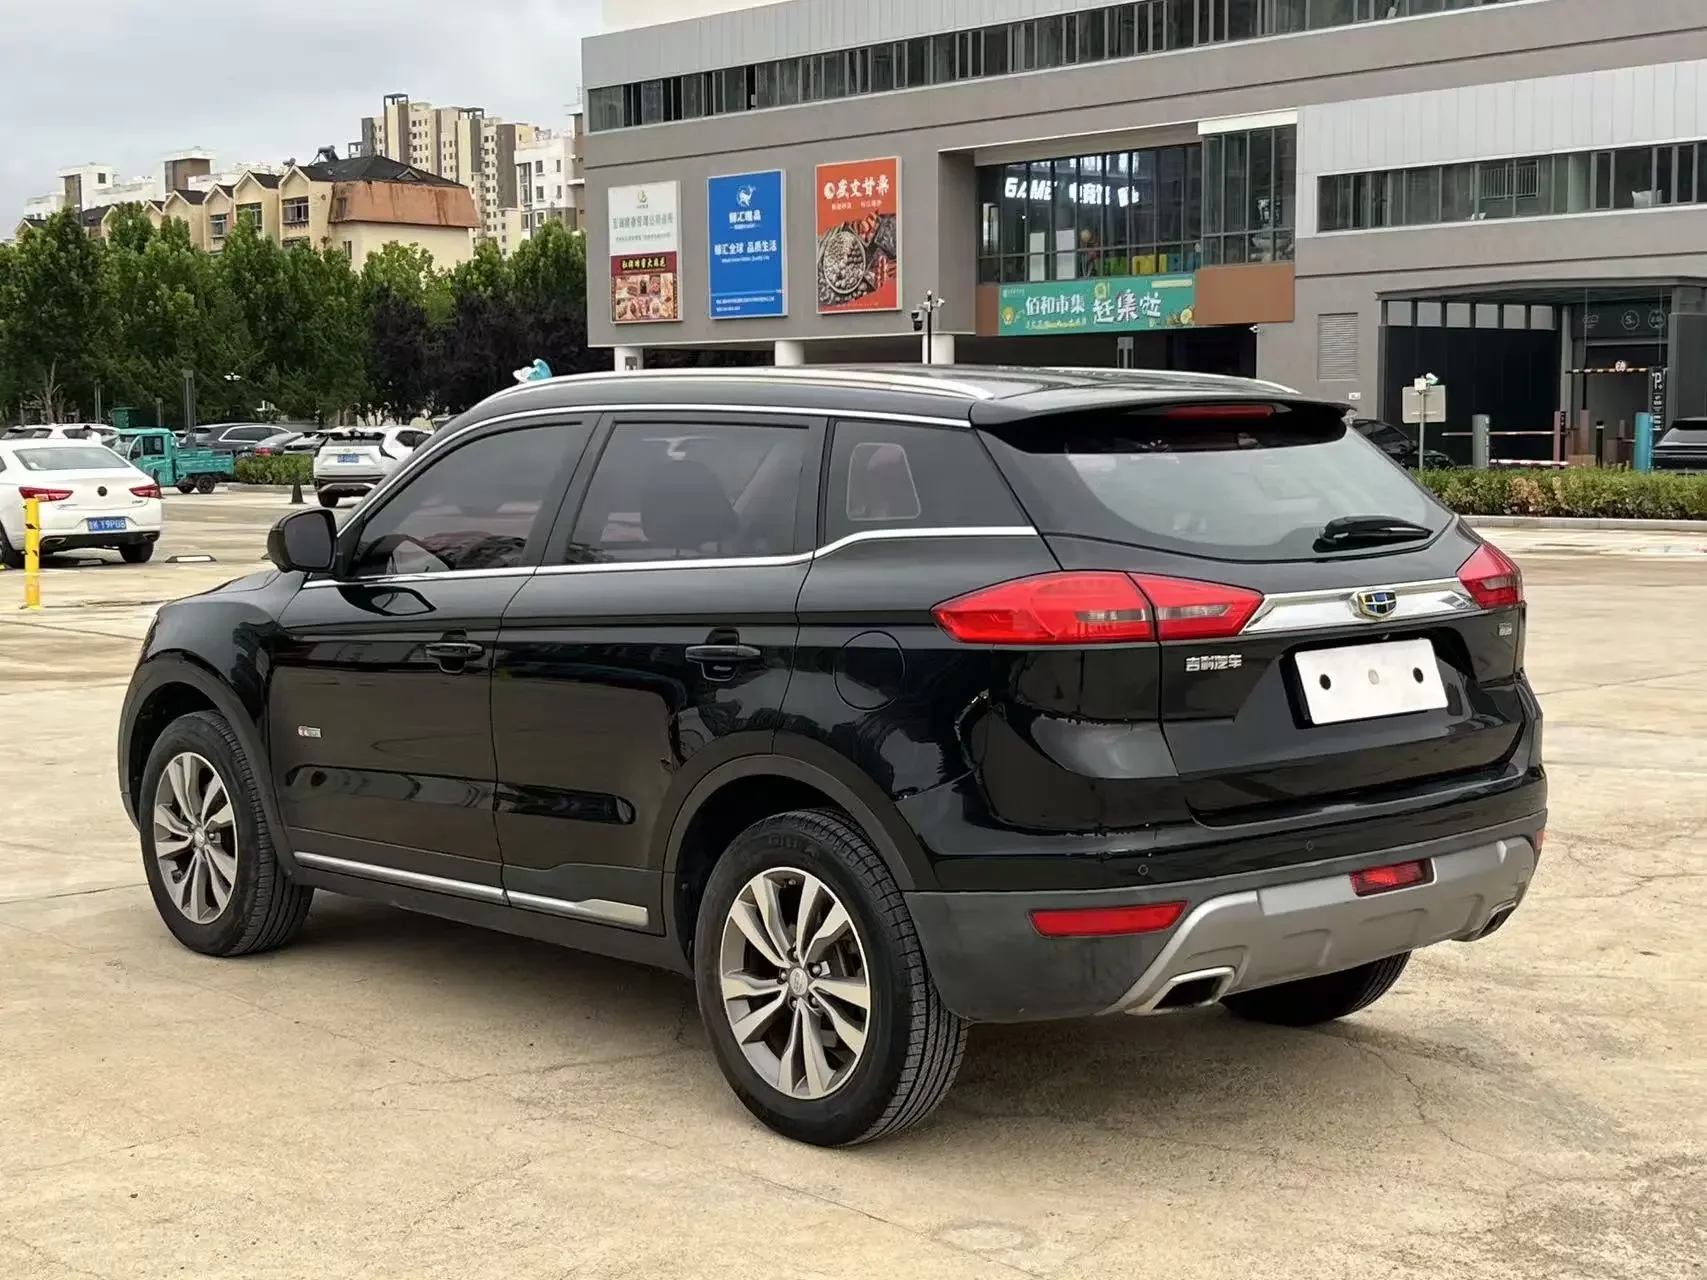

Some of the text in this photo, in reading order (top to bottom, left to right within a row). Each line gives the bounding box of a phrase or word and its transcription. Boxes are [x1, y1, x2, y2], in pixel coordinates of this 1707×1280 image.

[1025, 294, 1085, 316] 佰和市集
[1185, 654, 1242, 671] 吉利汽车
